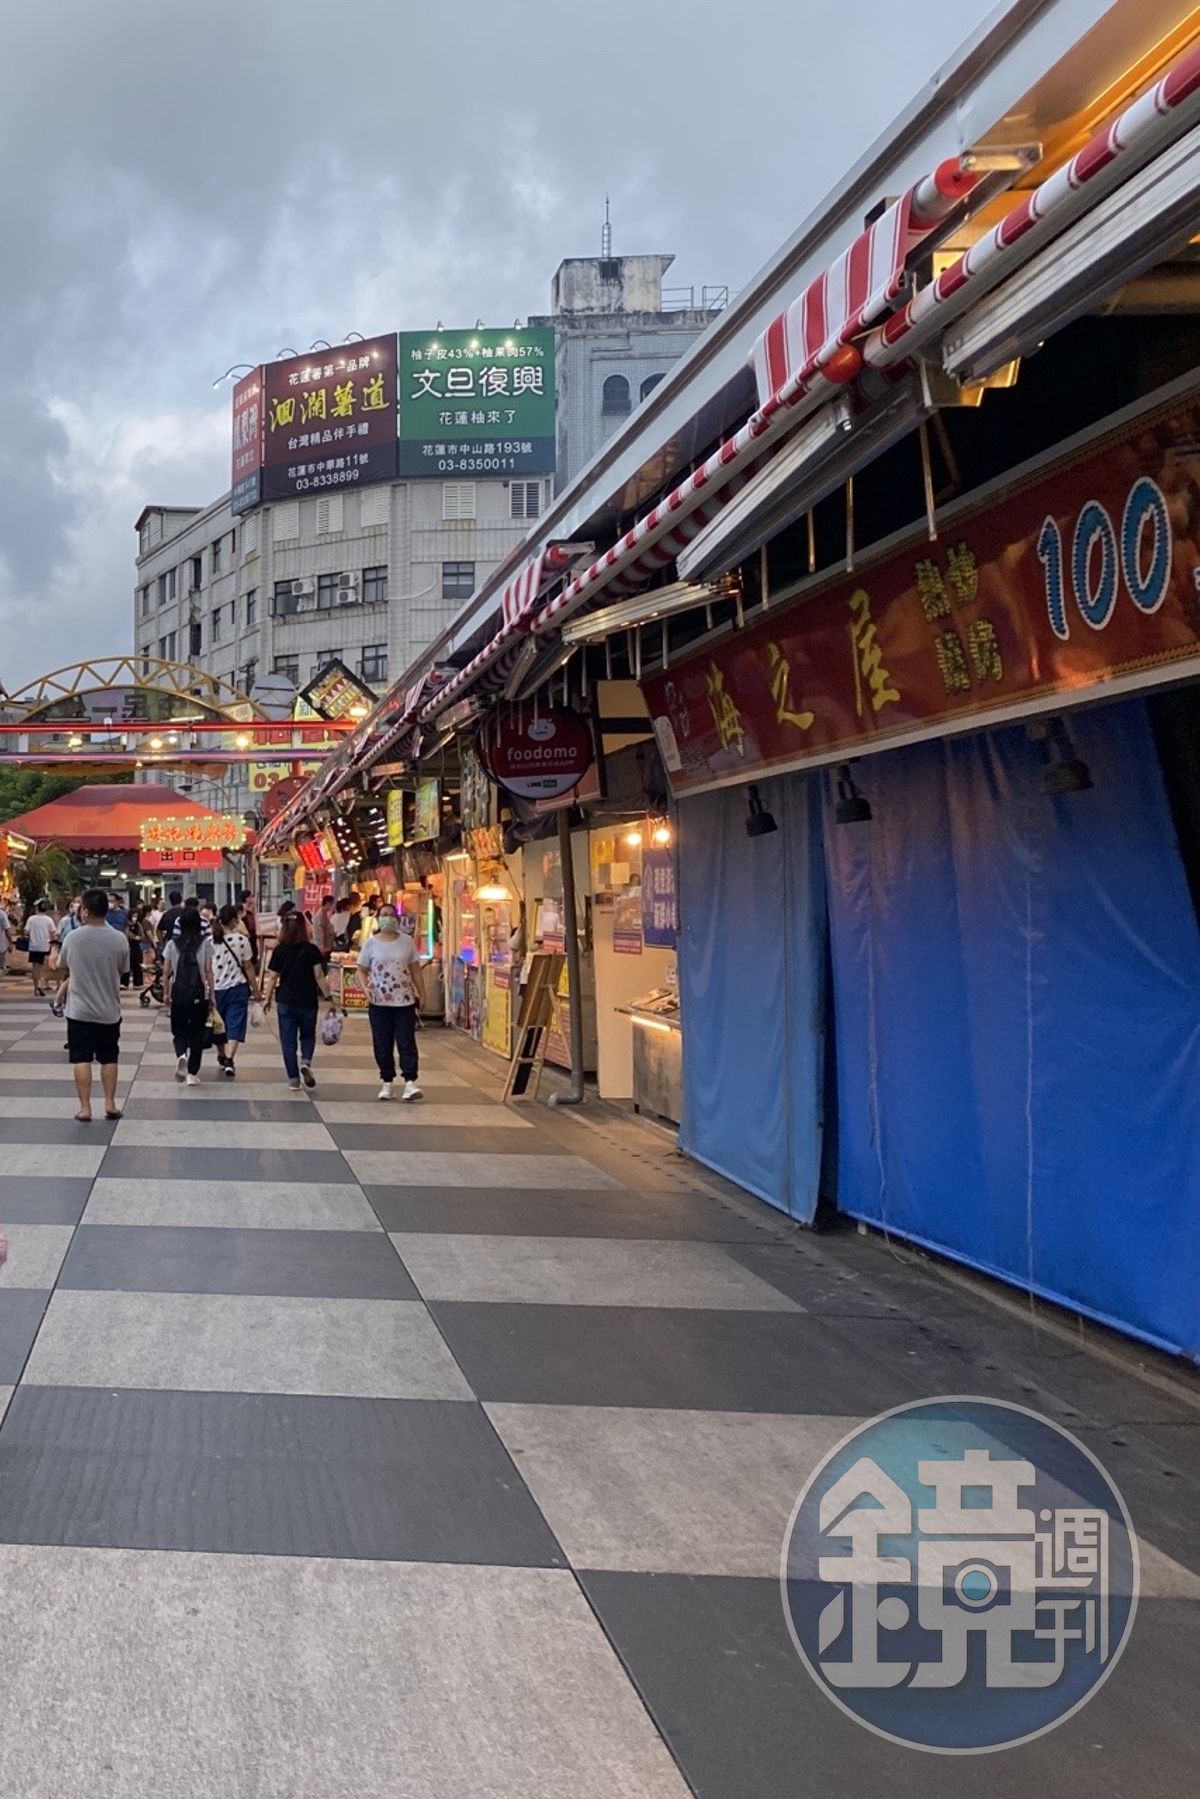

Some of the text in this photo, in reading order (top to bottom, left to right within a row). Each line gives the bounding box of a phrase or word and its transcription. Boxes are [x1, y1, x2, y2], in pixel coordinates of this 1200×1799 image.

[411, 366, 544, 399] 文旦復興
[439, 409, 516, 425] 花蓮柚來了
[287, 422, 370, 450] 台灣精品伴手禮
[422, 442, 534, 456] 花蓮市中山路193號
[438, 458, 516, 471] 03-8350011
[295, 469, 360, 491] 03-8338899
[1037, 476, 1172, 640] 100
[507, 746, 578, 761] foodomo
